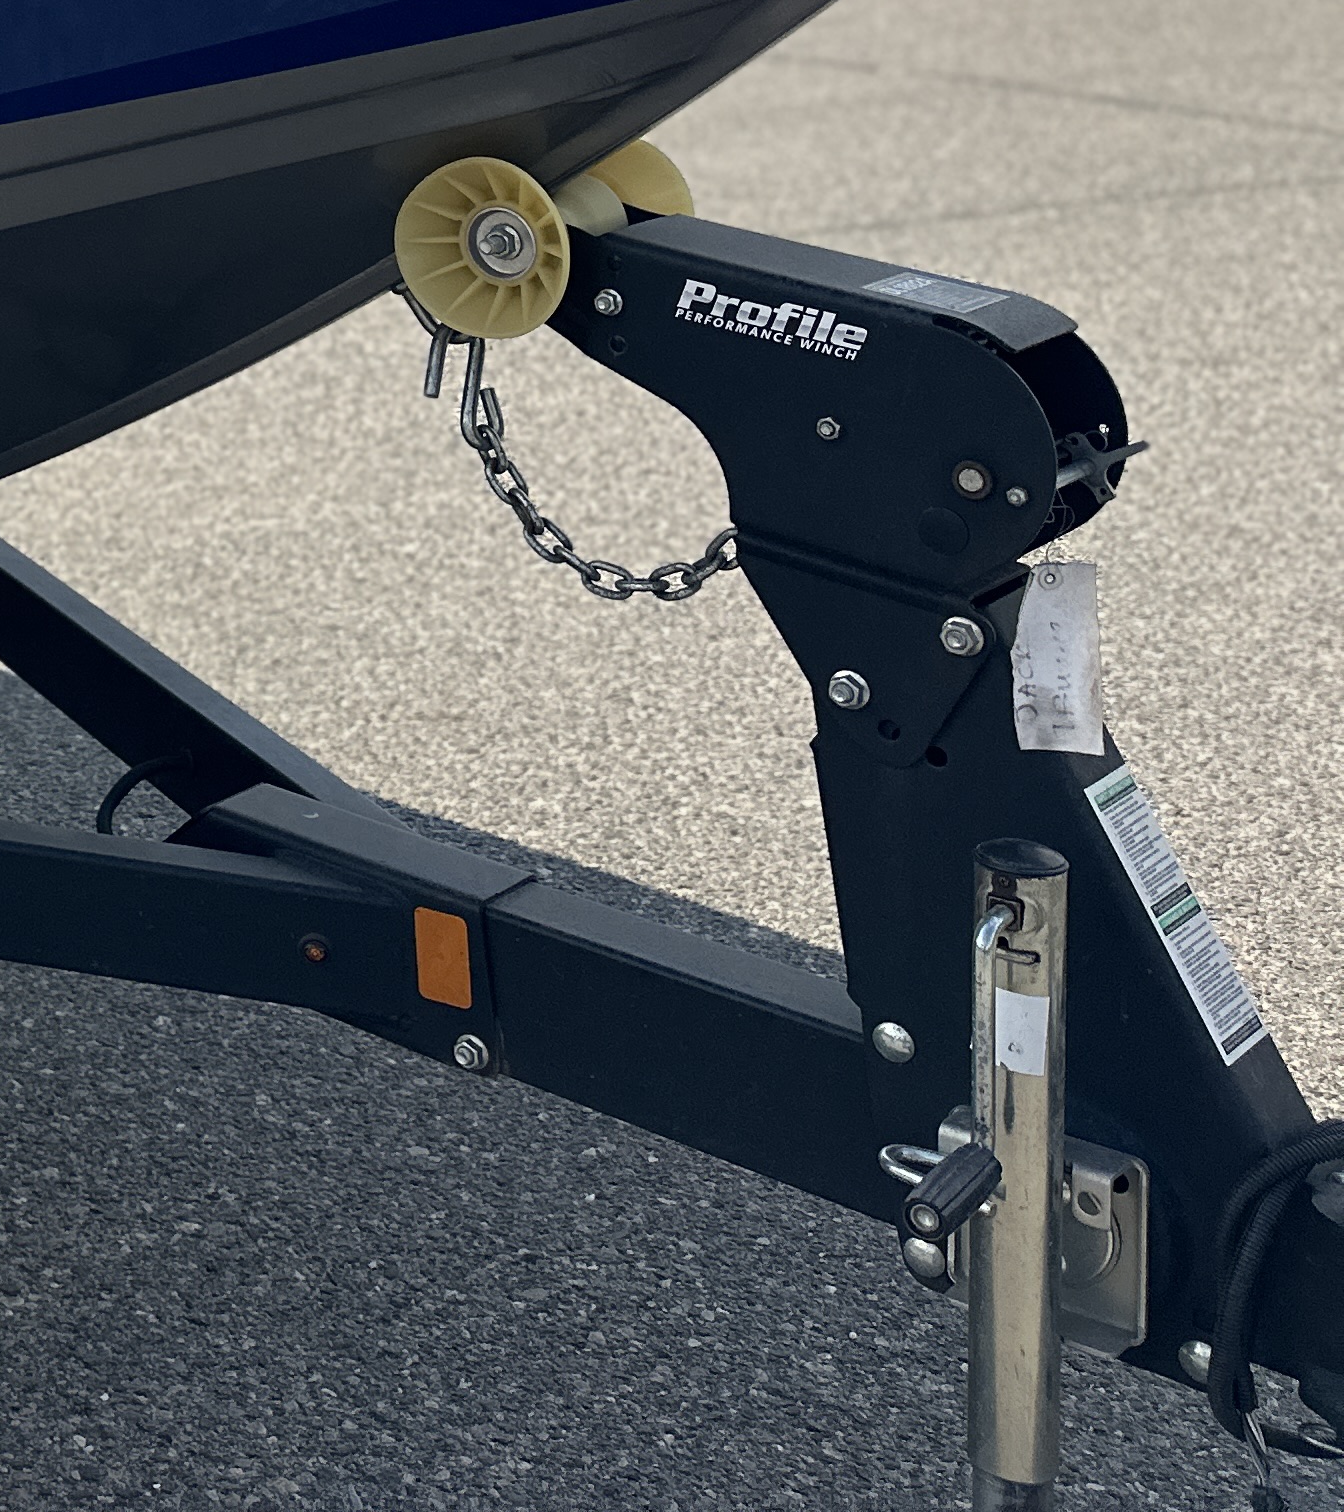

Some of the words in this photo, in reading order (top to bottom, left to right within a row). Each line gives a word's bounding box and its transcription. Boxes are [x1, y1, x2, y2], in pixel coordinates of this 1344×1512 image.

[675, 308, 793, 345] PERFORMANCE
[799, 338, 858, 361] WINCH
[676, 278, 868, 351] Profile
